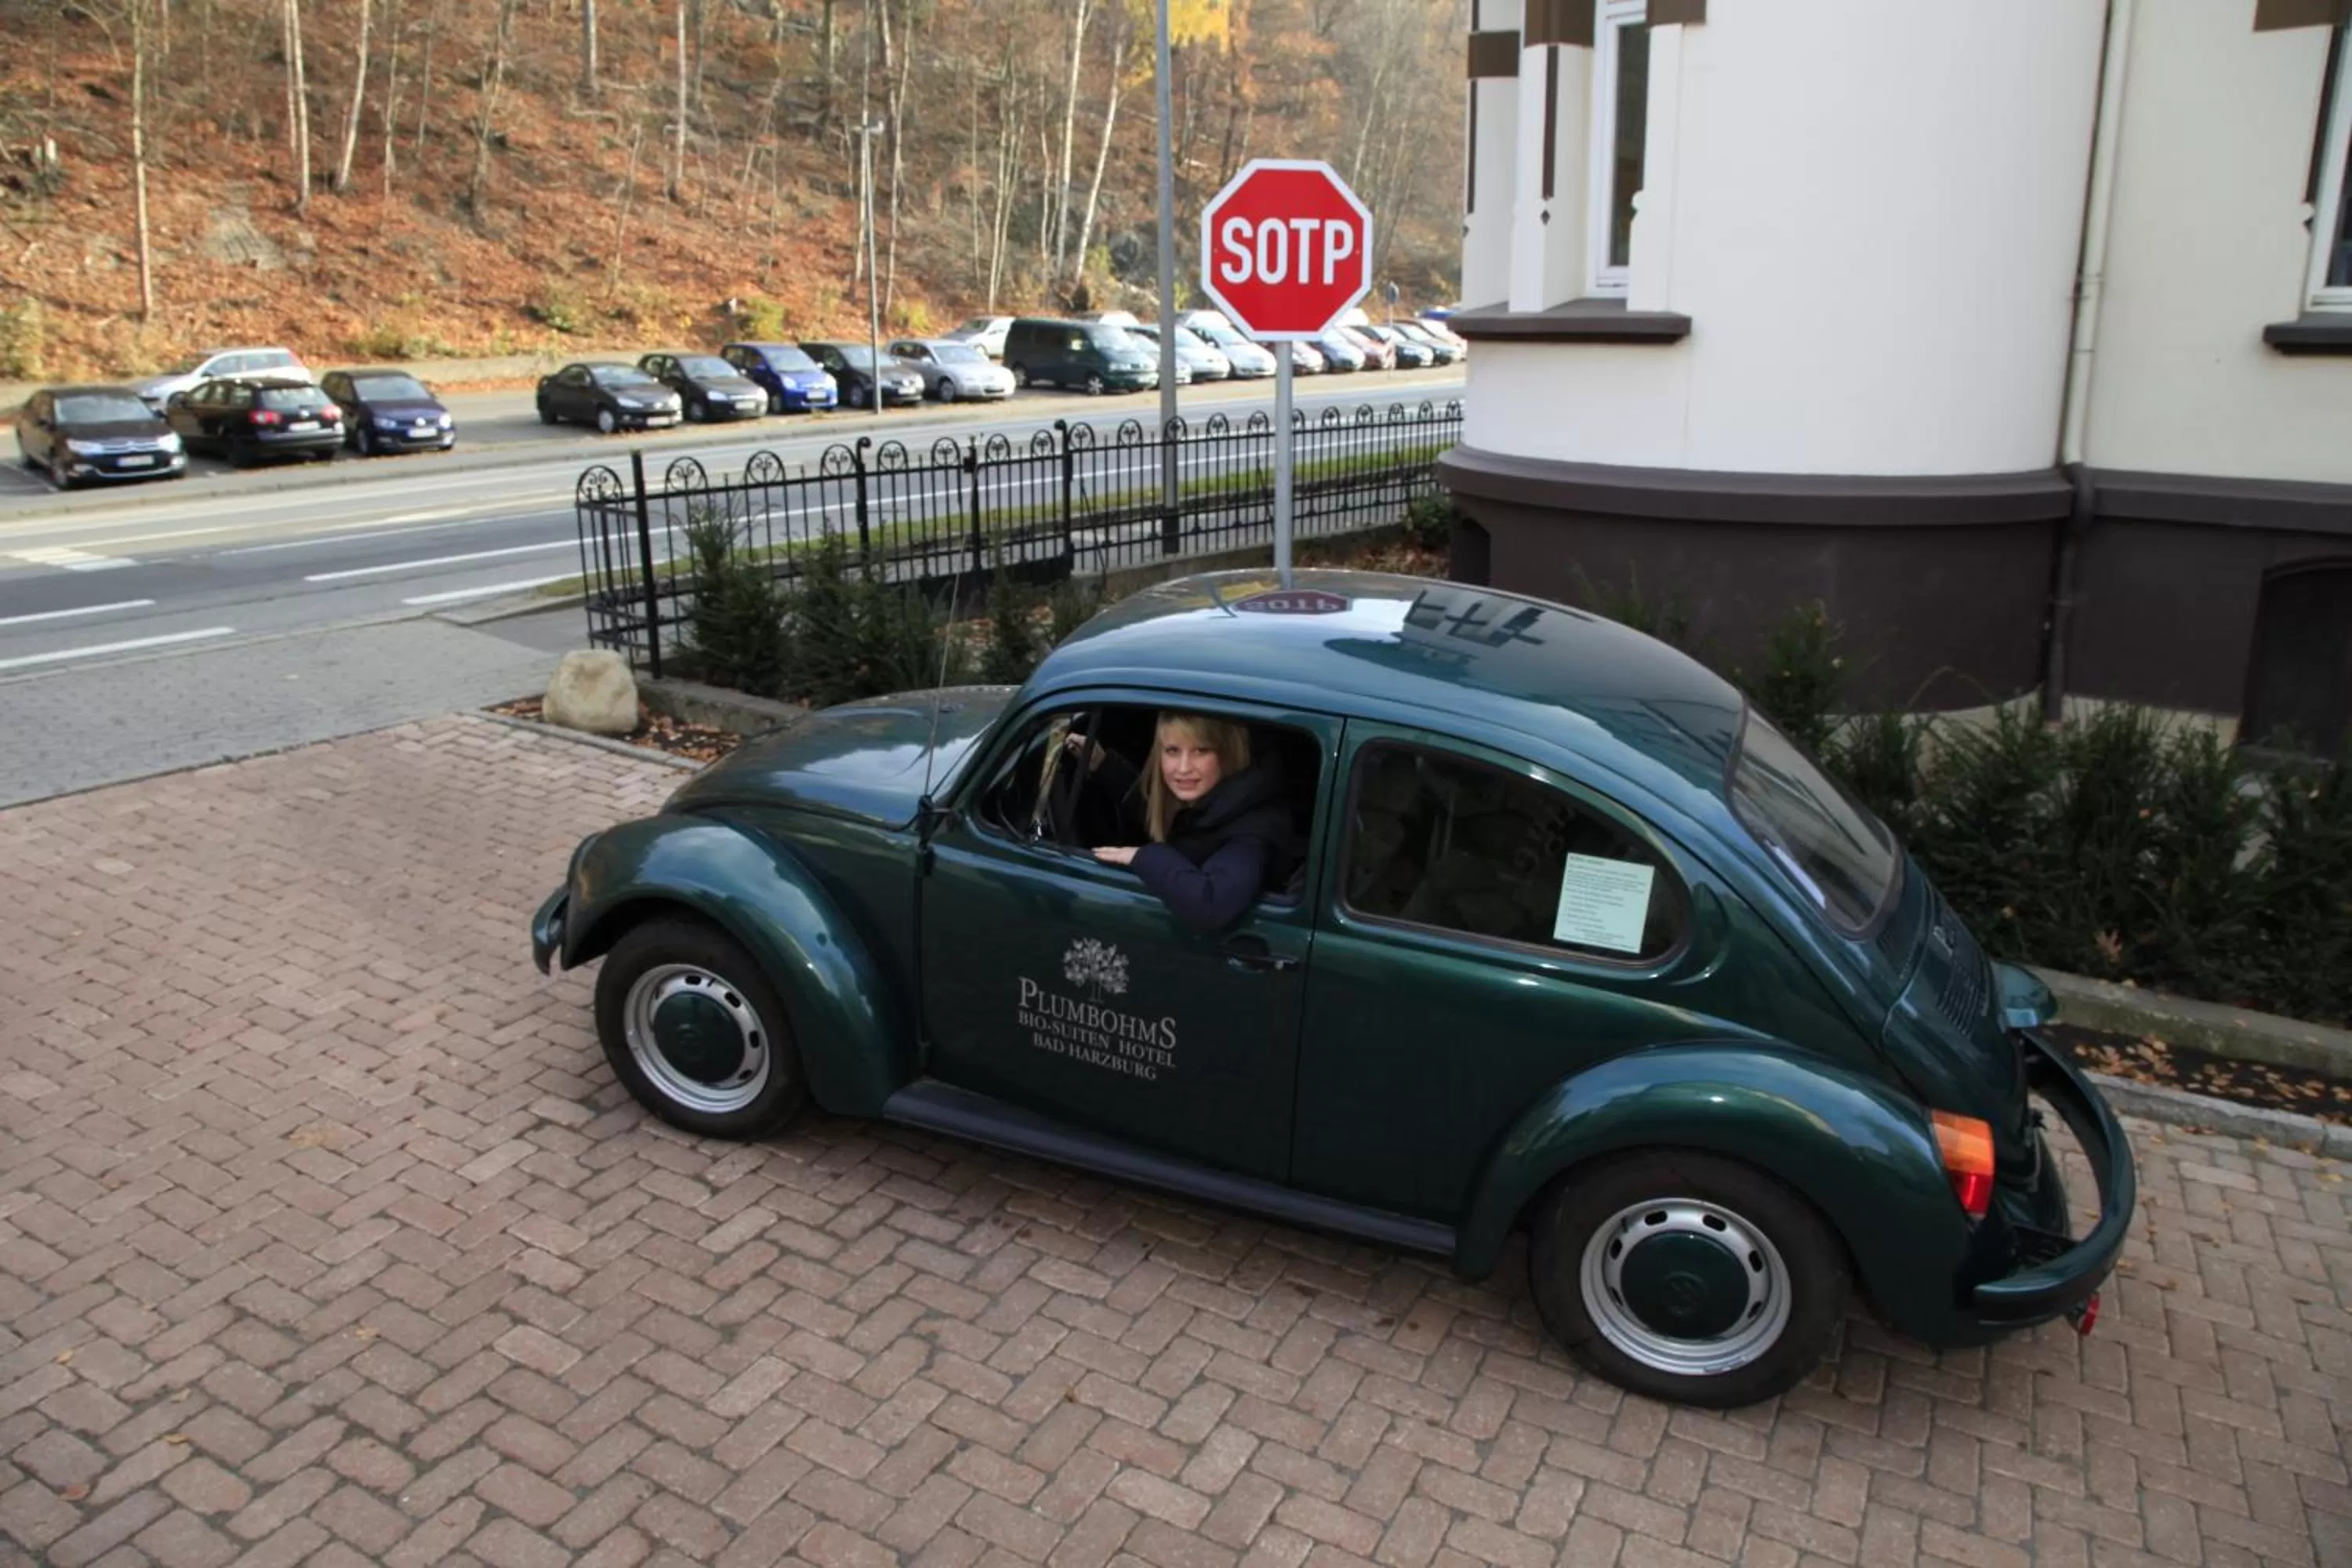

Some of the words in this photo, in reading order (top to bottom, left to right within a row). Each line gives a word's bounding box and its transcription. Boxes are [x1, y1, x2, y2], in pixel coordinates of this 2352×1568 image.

[1221, 216, 1354, 285] SOTP
[1033, 1031, 1065, 1054] BAD
[1068, 1043, 1157, 1080] HARZBURG
[1118, 1039, 1177, 1069] HOTEL
